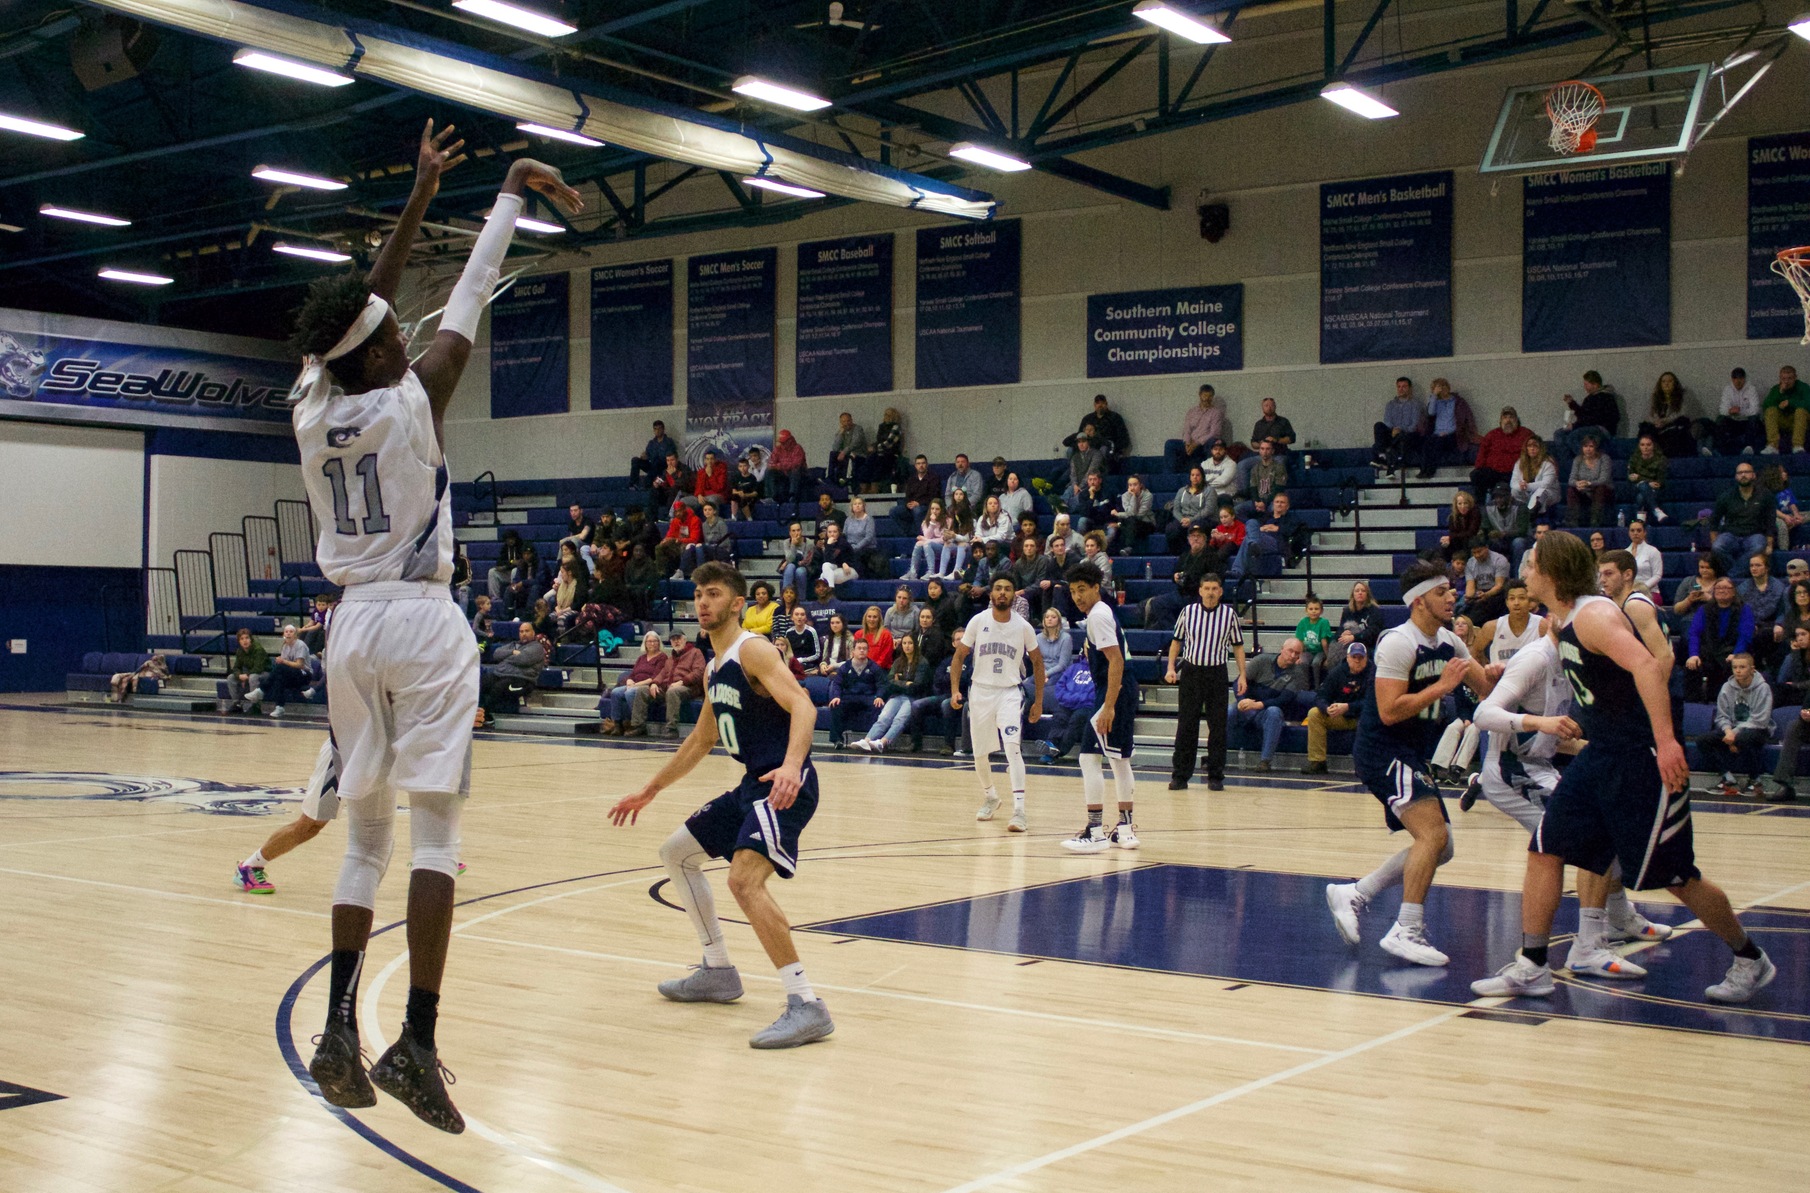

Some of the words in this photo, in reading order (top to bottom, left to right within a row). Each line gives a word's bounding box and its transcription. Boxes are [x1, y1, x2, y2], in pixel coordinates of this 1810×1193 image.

[1752, 147, 1786, 164] SMCC
[1788, 145, 1810, 161] Wo
[1527, 174, 1556, 187] SMCC
[1559, 170, 1606, 185] Women's
[1609, 162, 1667, 180] Basketball
[1326, 193, 1355, 208] SMCC
[1357, 190, 1387, 206] Men's
[1390, 182, 1446, 202] Basketball
[940, 235, 963, 249] SMCC
[964, 230, 996, 245] Softball
[817, 249, 839, 263] SMCC
[840, 244, 875, 260] Baseball
[593, 270, 614, 281] SMCC
[614, 267, 645, 278] Women's
[645, 264, 669, 275] Soccer
[699, 263, 719, 276] SMCC
[719, 262, 741, 273] Men's
[741, 259, 765, 271] Soccer
[513, 285, 531, 298] SMCC
[1105, 304, 1171, 321] Southern
[1175, 299, 1223, 315] Maine
[1094, 324, 1175, 342] Community
[1178, 321, 1235, 337] College
[1107, 342, 1221, 363] Championships
[39, 358, 294, 411] SeaWolve
[687, 413, 771, 427] WOLFPACK
[321, 452, 391, 536] 11
[810, 608, 836, 618] PATRIOTS
[992, 657, 1003, 673] 2
[718, 711, 740, 755] 0
